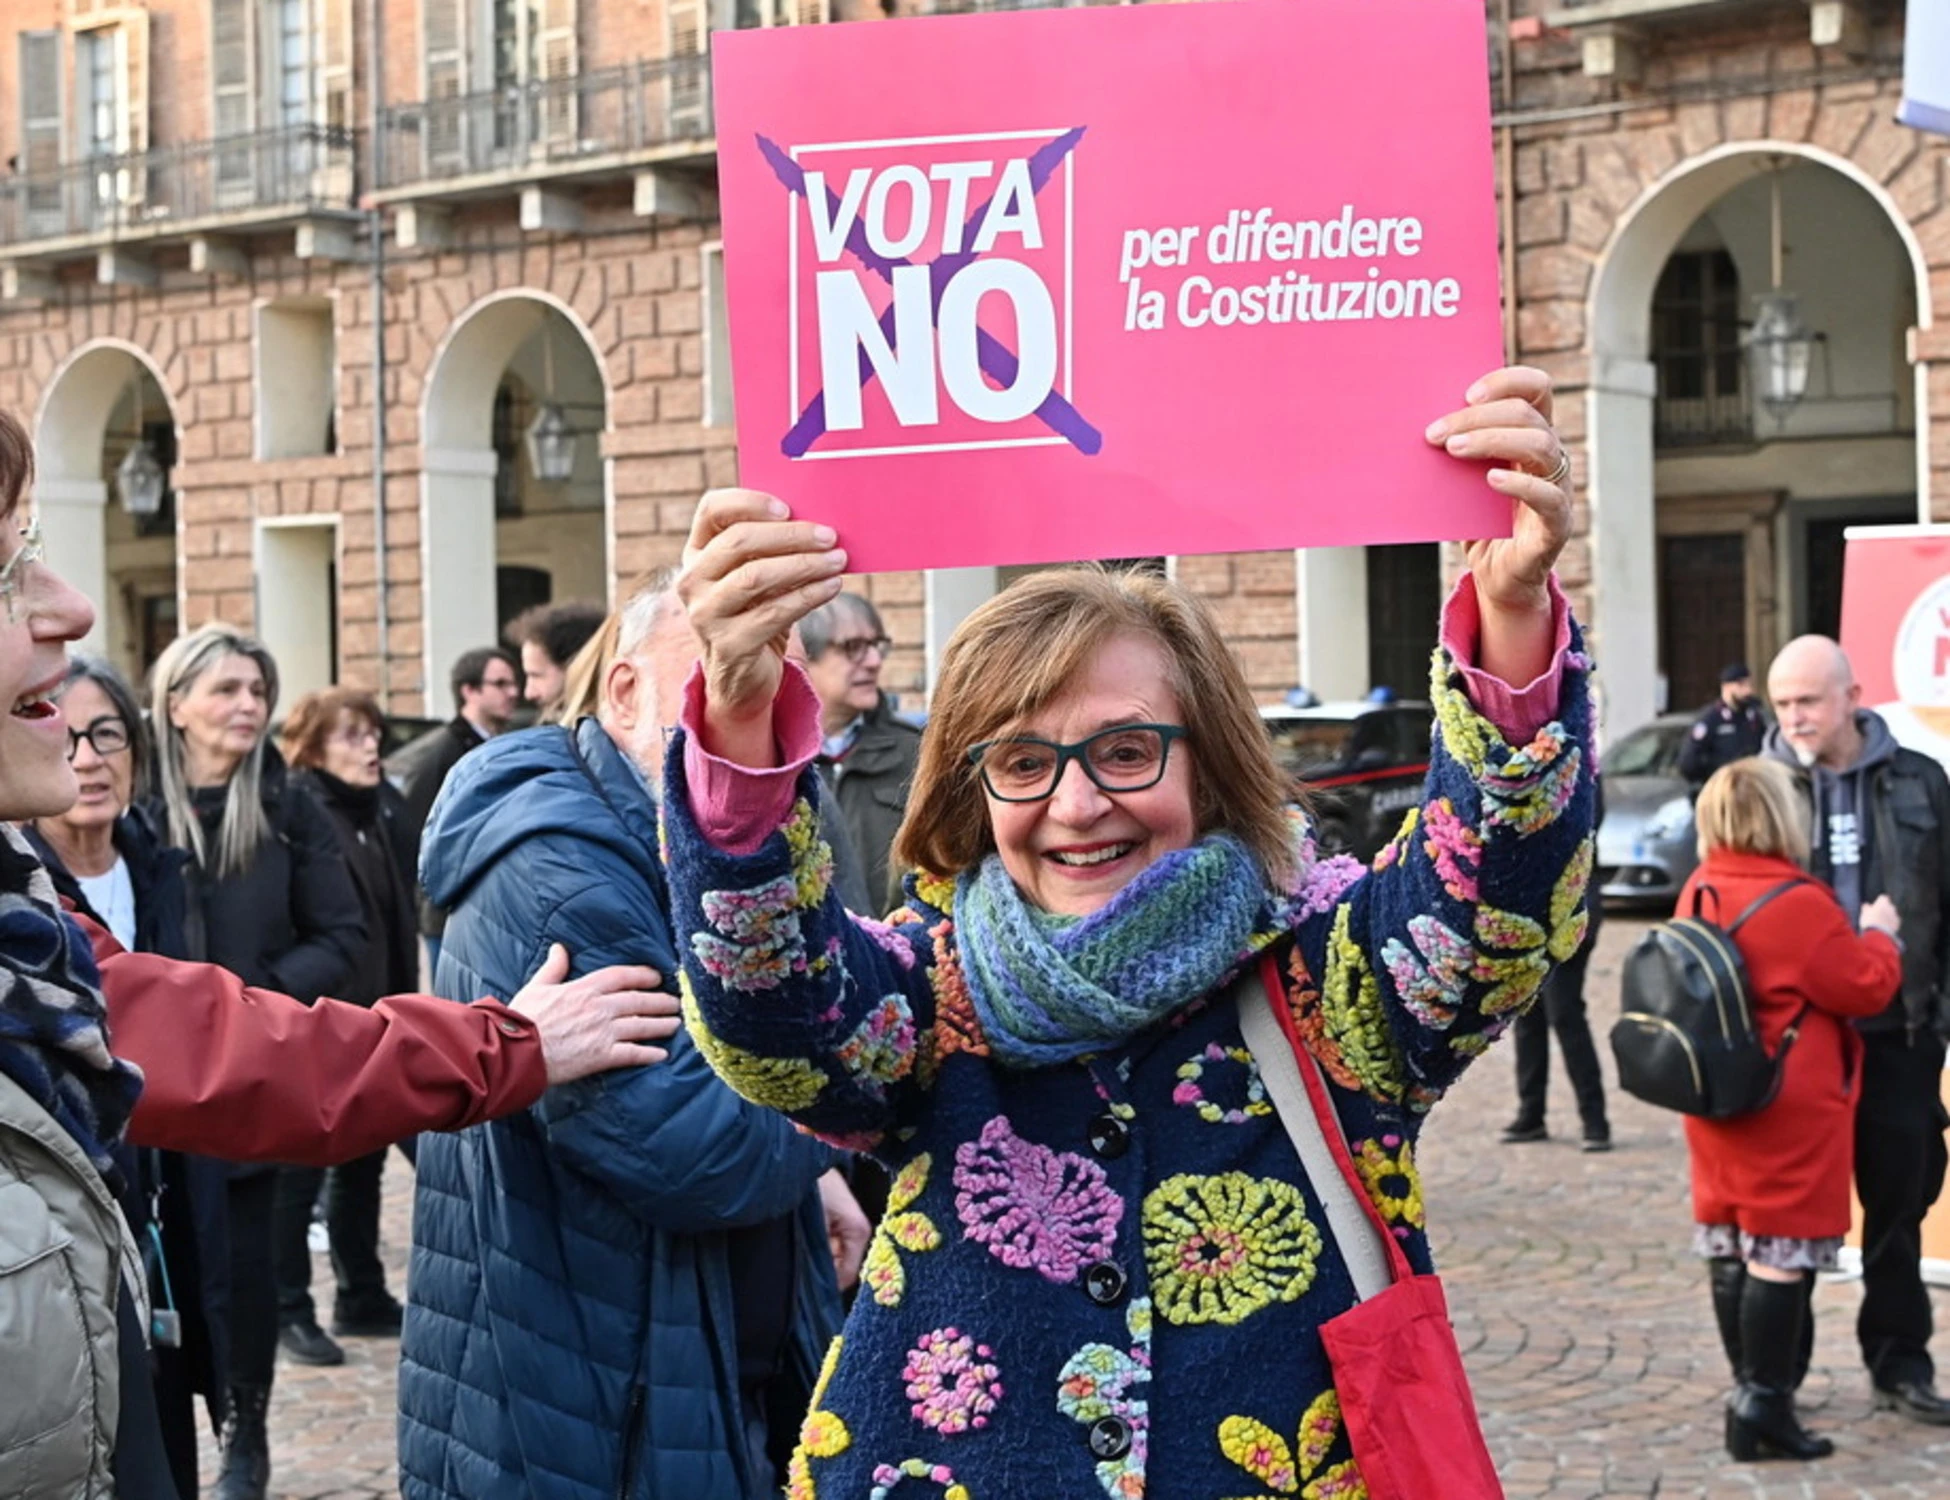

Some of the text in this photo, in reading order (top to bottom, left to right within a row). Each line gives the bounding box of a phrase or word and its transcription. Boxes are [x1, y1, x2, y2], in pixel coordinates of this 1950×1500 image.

[803, 158, 1044, 263] VOTA
[1121, 204, 1423, 282] per difendere
[1124, 267, 1460, 331] la Costituzione
[816, 258, 1058, 432] NO
